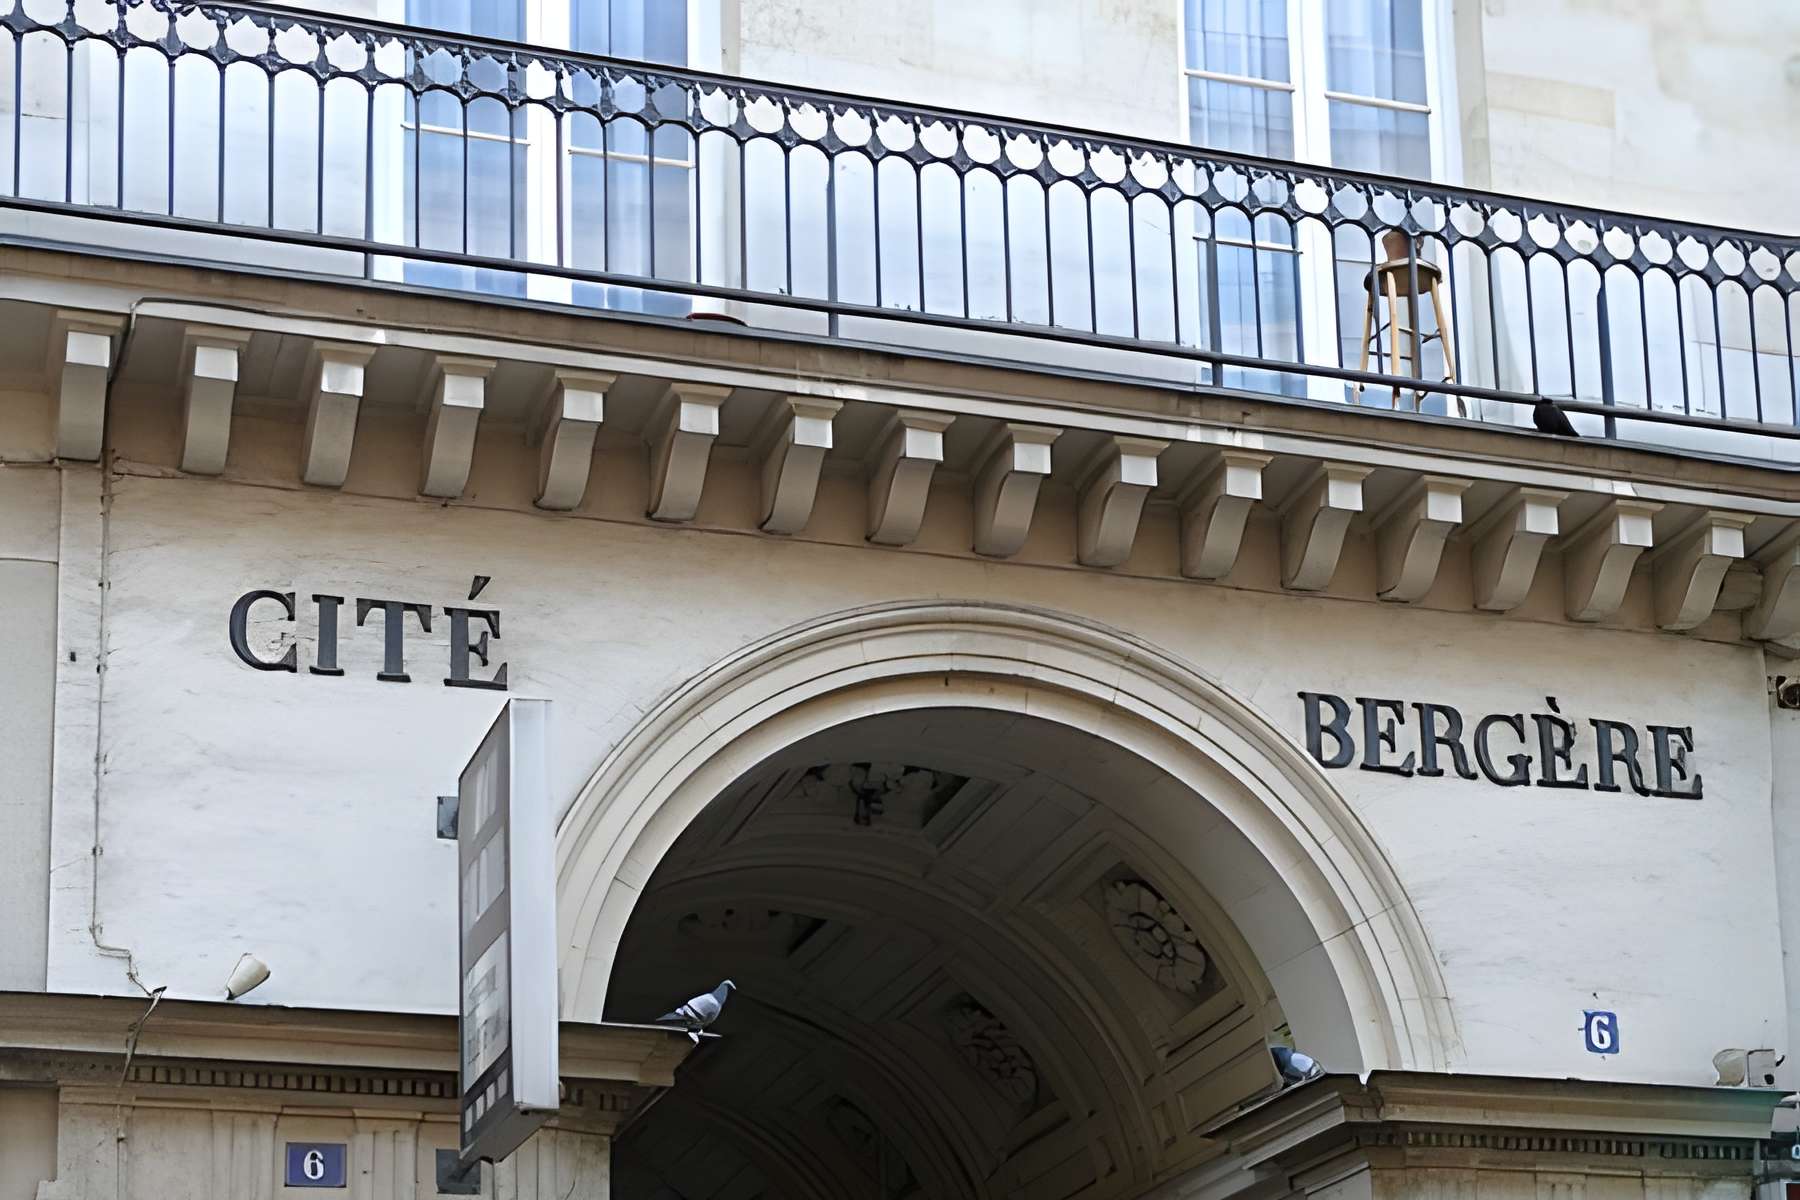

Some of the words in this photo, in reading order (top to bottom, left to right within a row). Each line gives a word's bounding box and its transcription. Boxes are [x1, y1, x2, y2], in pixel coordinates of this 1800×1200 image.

[229, 575, 508, 691] CITÉ
[1297, 691, 1703, 800] BERGÈRE
[1591, 1015, 1611, 1050] 6
[303, 1150, 324, 1180] 6
